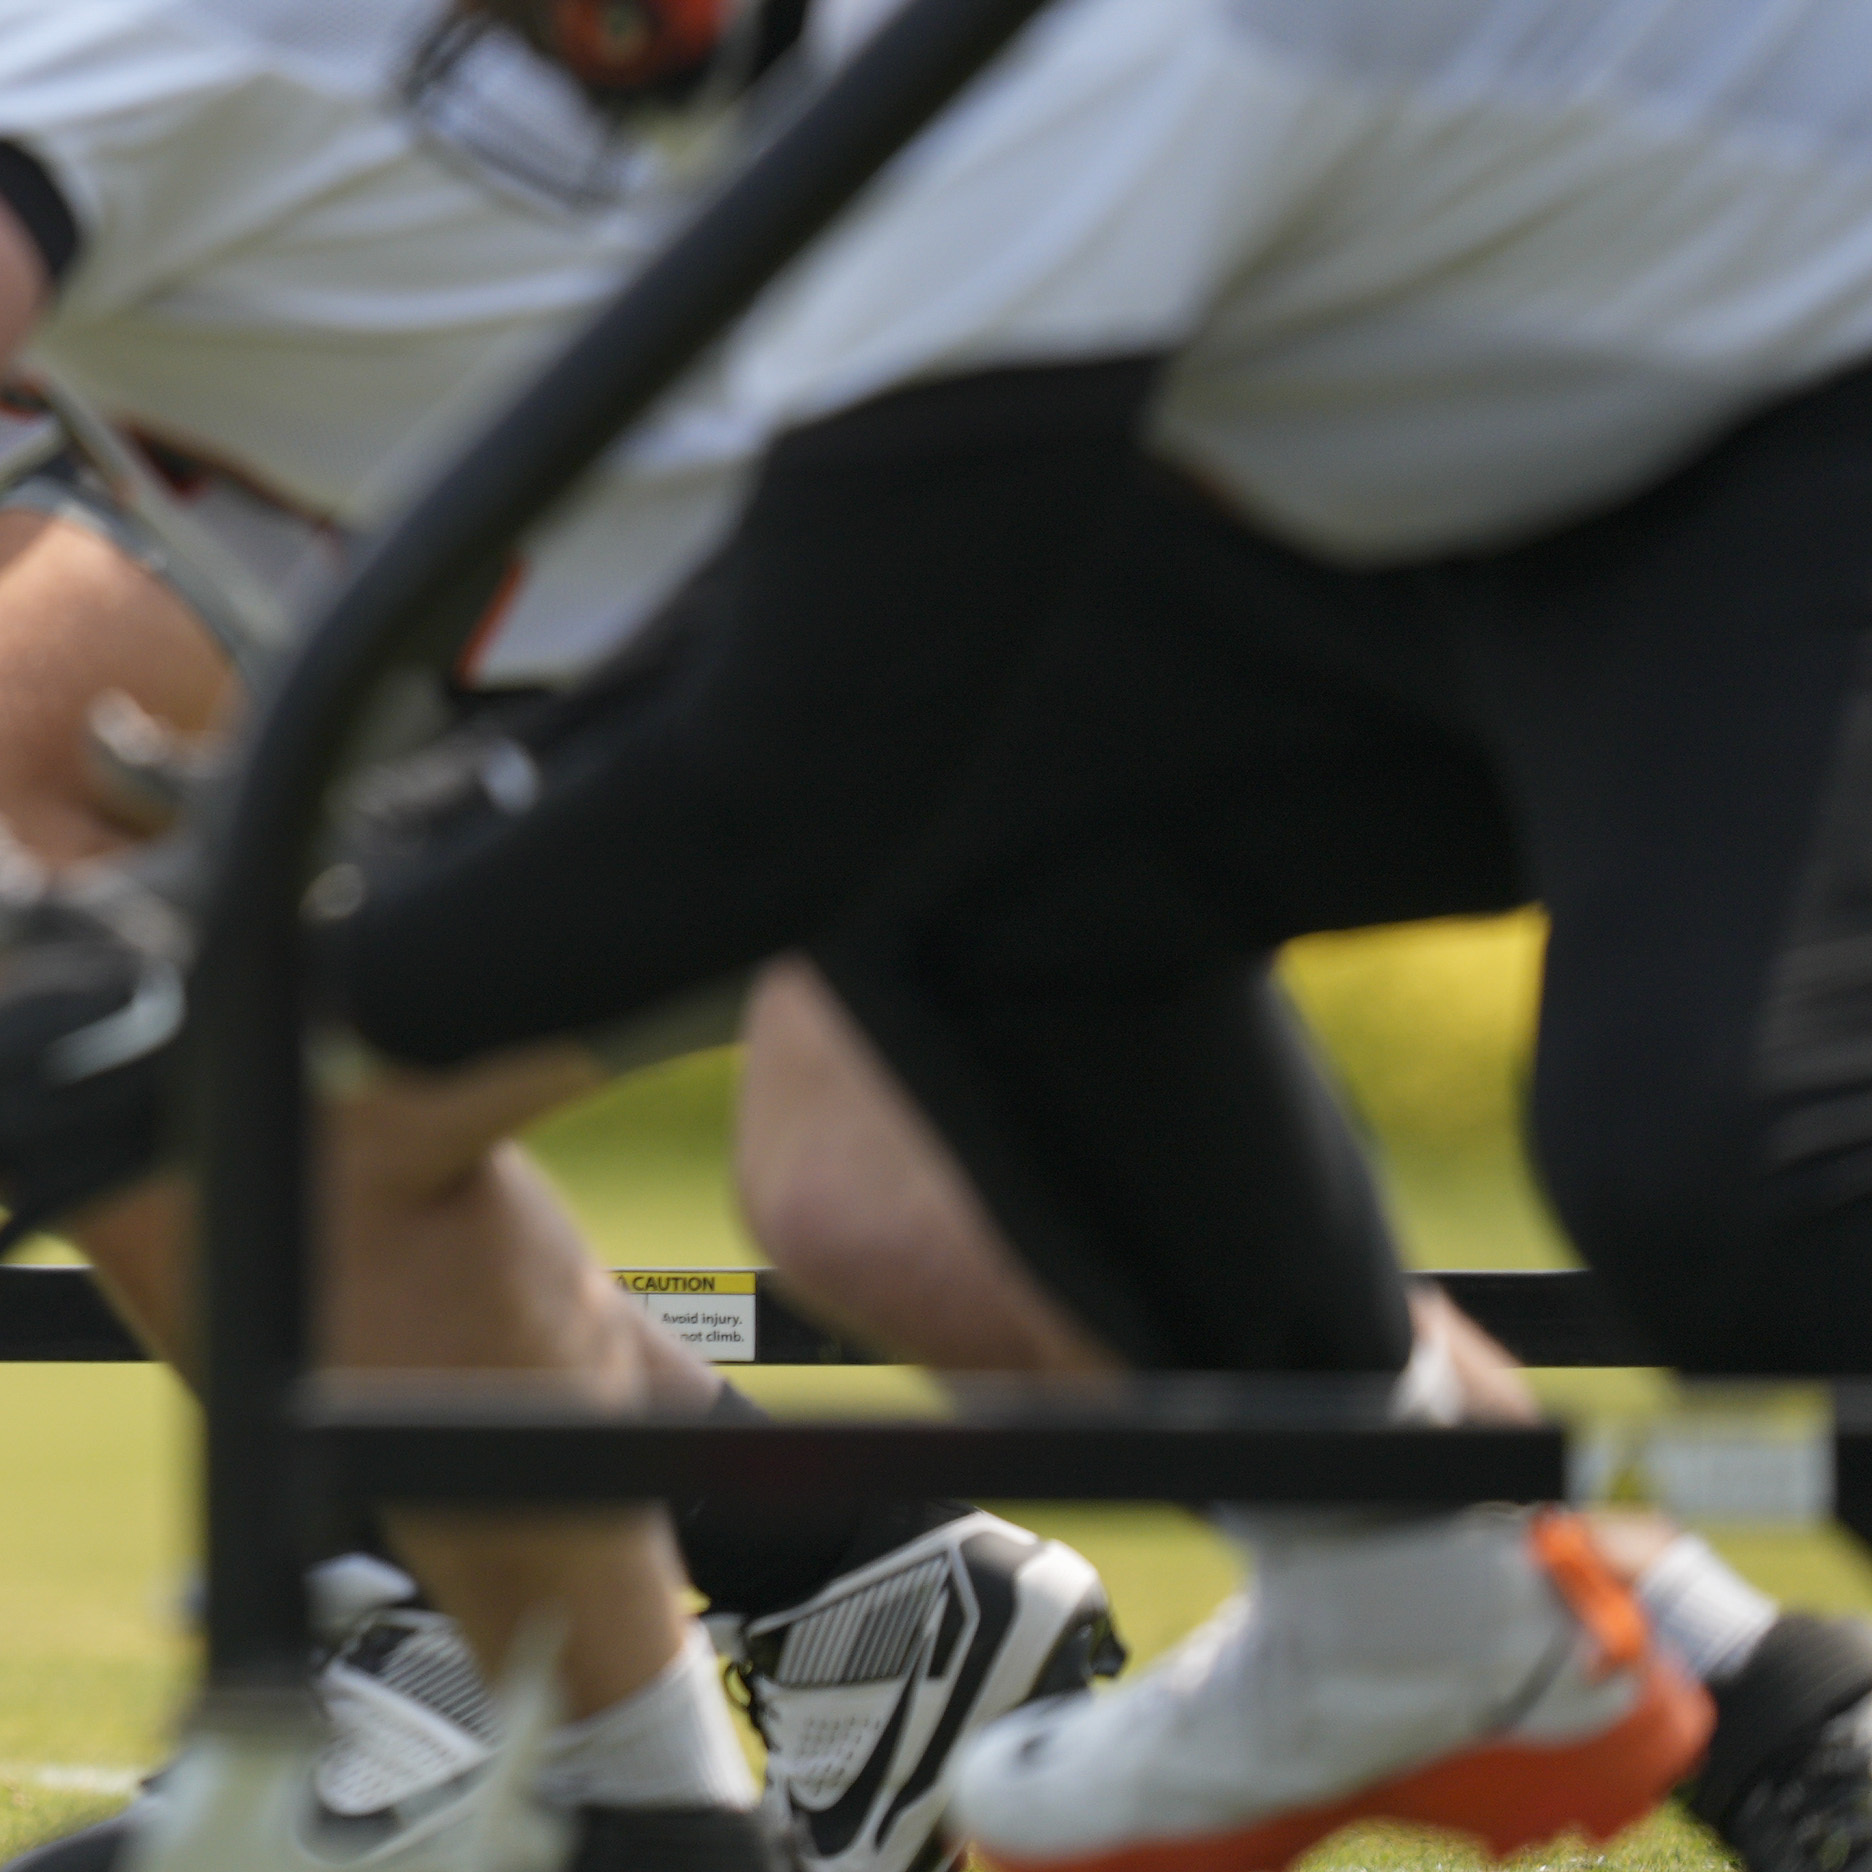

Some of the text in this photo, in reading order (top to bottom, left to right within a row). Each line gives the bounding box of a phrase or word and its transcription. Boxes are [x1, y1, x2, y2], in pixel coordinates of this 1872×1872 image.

[632, 1276, 715, 1292] CAUTION
[662, 1312, 743, 1327] Avoid injury.
[706, 1331, 744, 1342] climb.
